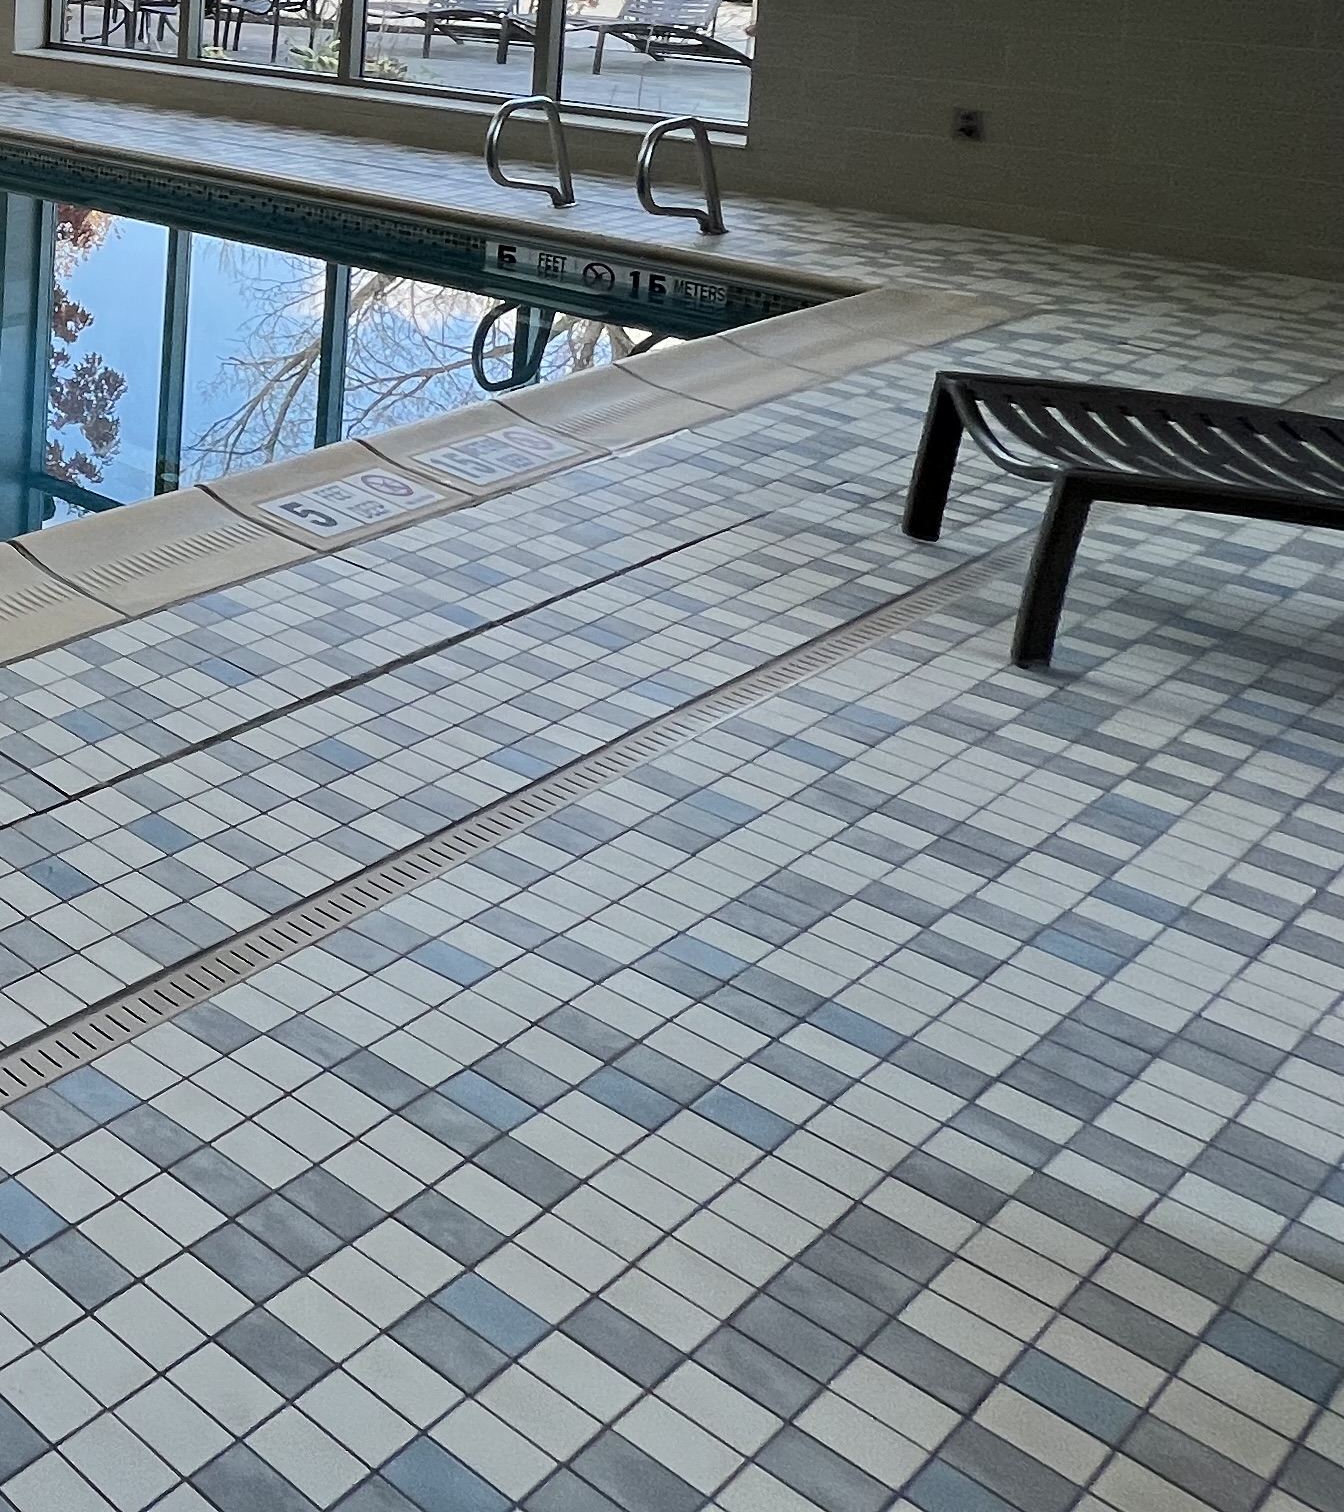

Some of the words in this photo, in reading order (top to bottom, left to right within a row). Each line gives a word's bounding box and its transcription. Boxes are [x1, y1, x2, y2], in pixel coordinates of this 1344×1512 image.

[497, 244, 517, 265] 5
[538, 252, 568, 273] FEET
[673, 279, 727, 303] METERS
[280, 501, 338, 528] 5
